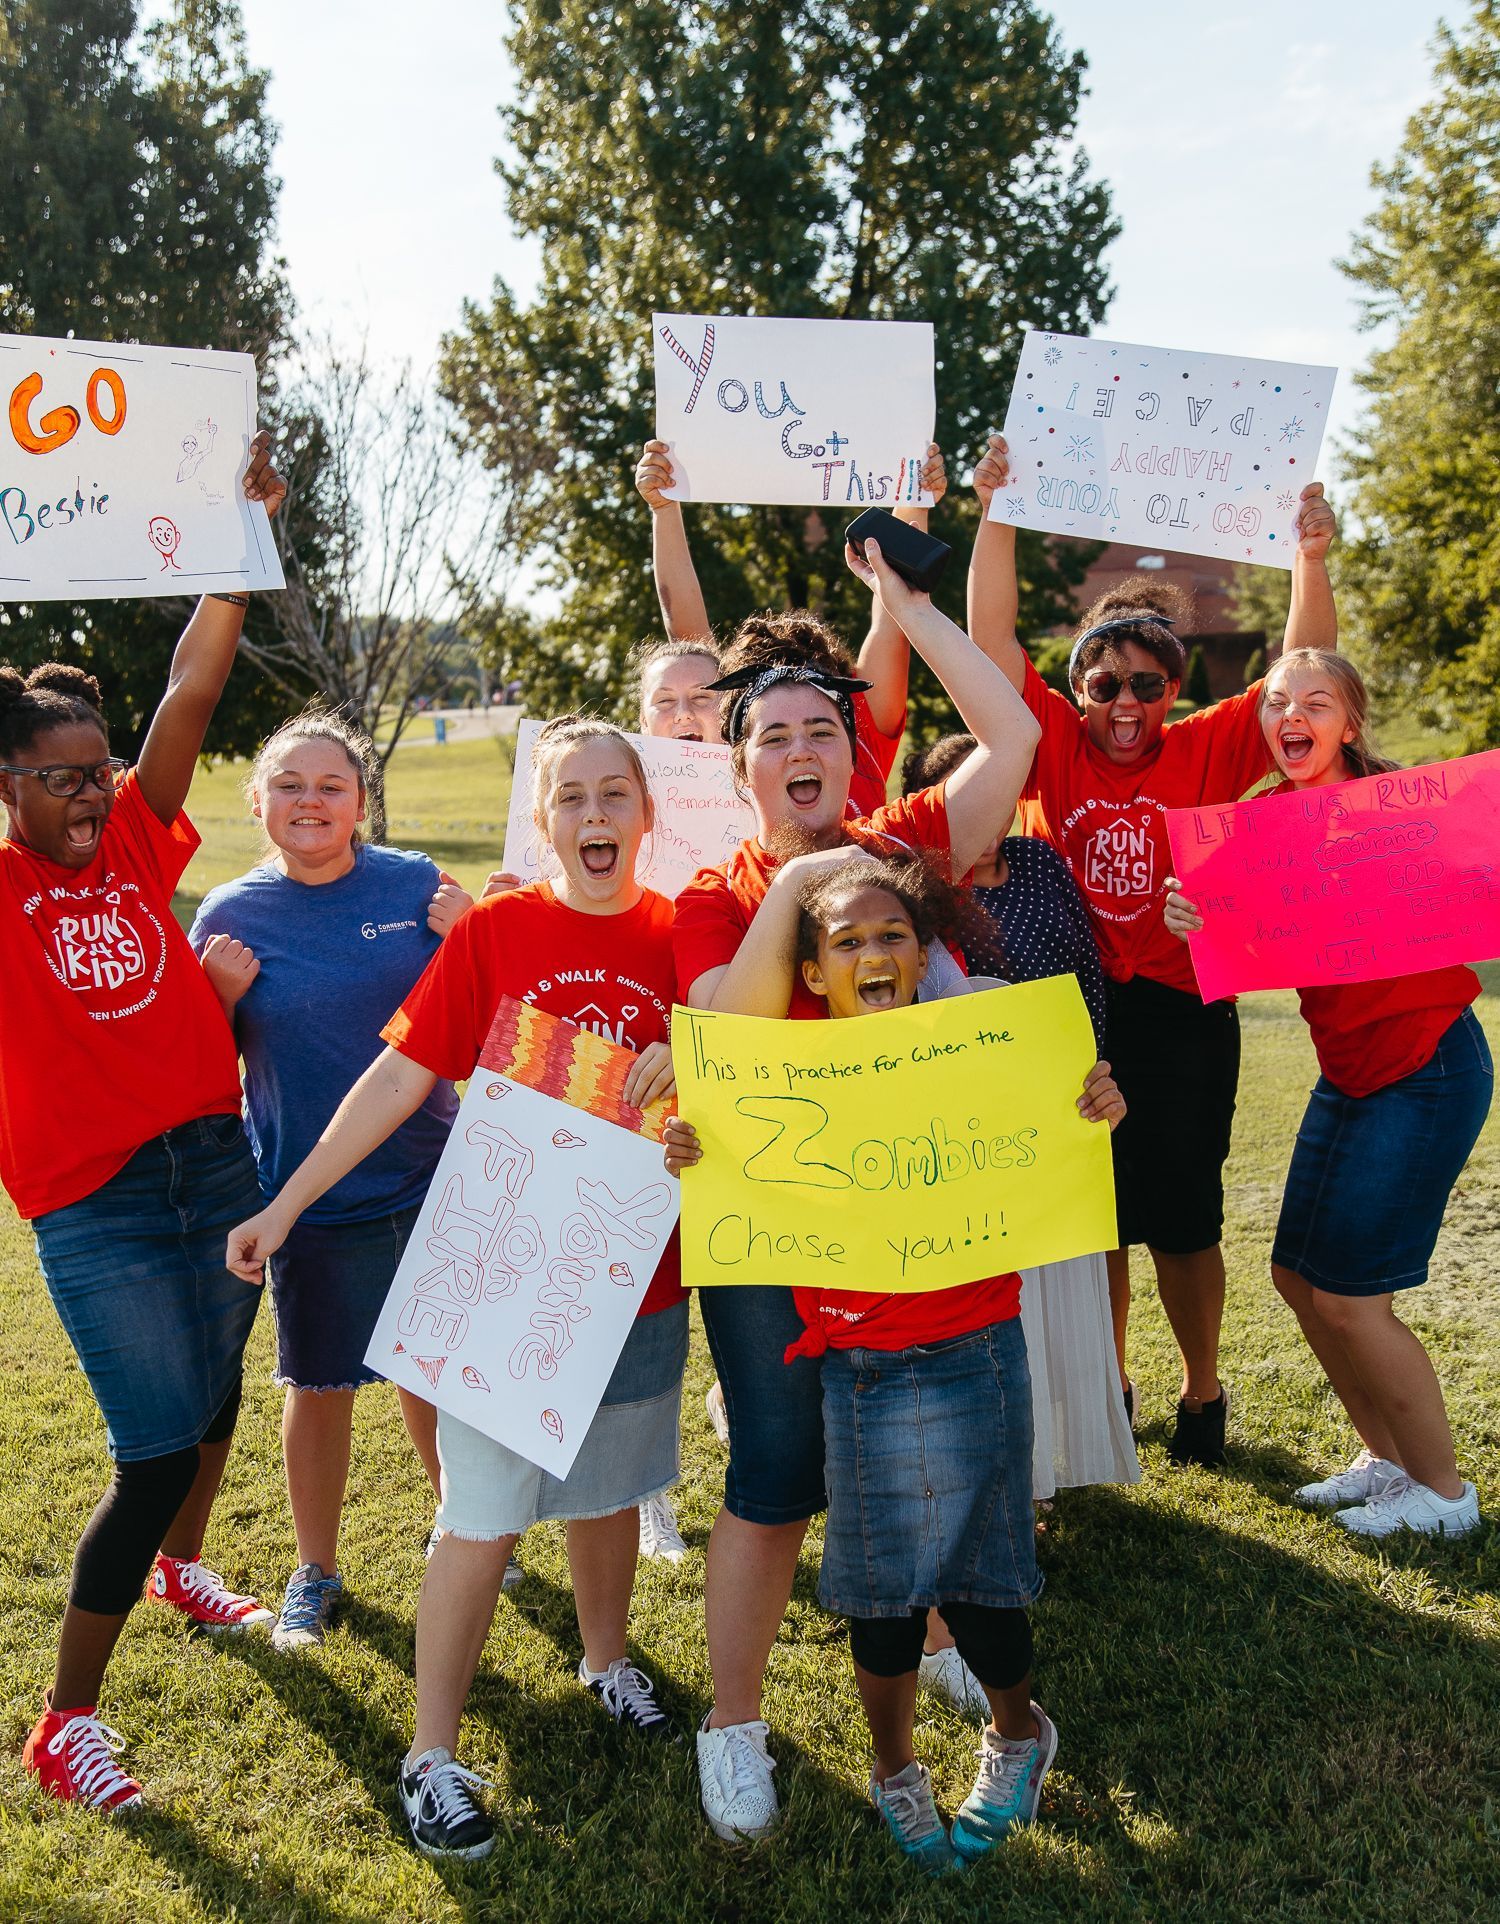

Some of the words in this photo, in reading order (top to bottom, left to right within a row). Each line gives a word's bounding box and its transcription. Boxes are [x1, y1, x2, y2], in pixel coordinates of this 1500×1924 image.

[660, 323, 806, 418] You
[9, 368, 127, 455] GO
[781, 419, 849, 458] Got
[812, 457, 922, 501] This!!!
[1110, 443, 1232, 482] HAPPY
[0, 476, 110, 544] Bestie
[1037, 475, 1120, 518] YOUR
[1146, 493, 1190, 528] TO
[1212, 503, 1262, 537] GO
[647, 762, 698, 778] ulous
[680, 745, 732, 761] Incred
[1193, 806, 1264, 844] LET
[1301, 793, 1349, 824] US
[1377, 771, 1447, 811] RUN
[1095, 828, 1145, 860] RUN
[1323, 828, 1428, 863] endurance
[1113, 853, 1129, 877] 4
[1280, 878, 1354, 908] RACE
[1387, 859, 1445, 890] GOD
[1344, 908, 1387, 929] SET
[1411, 884, 1500, 916] BEFORE
[58, 907, 124, 947] RUN
[148, 914, 167, 983] CHATTANOOGA
[538, 979, 552, 992] &
[554, 968, 606, 985] WALK
[112, 988, 157, 1019] LAWRENCE
[652, 998, 666, 1011] OF
[674, 1009, 737, 1082] This
[754, 1058, 770, 1079] is
[783, 1062, 863, 1091] practice
[872, 1055, 903, 1073] for
[975, 1030, 1014, 1045] the
[735, 1096, 1038, 1191] Zombies
[708, 1214, 848, 1266] Chase
[887, 1211, 1008, 1276] you!!!
